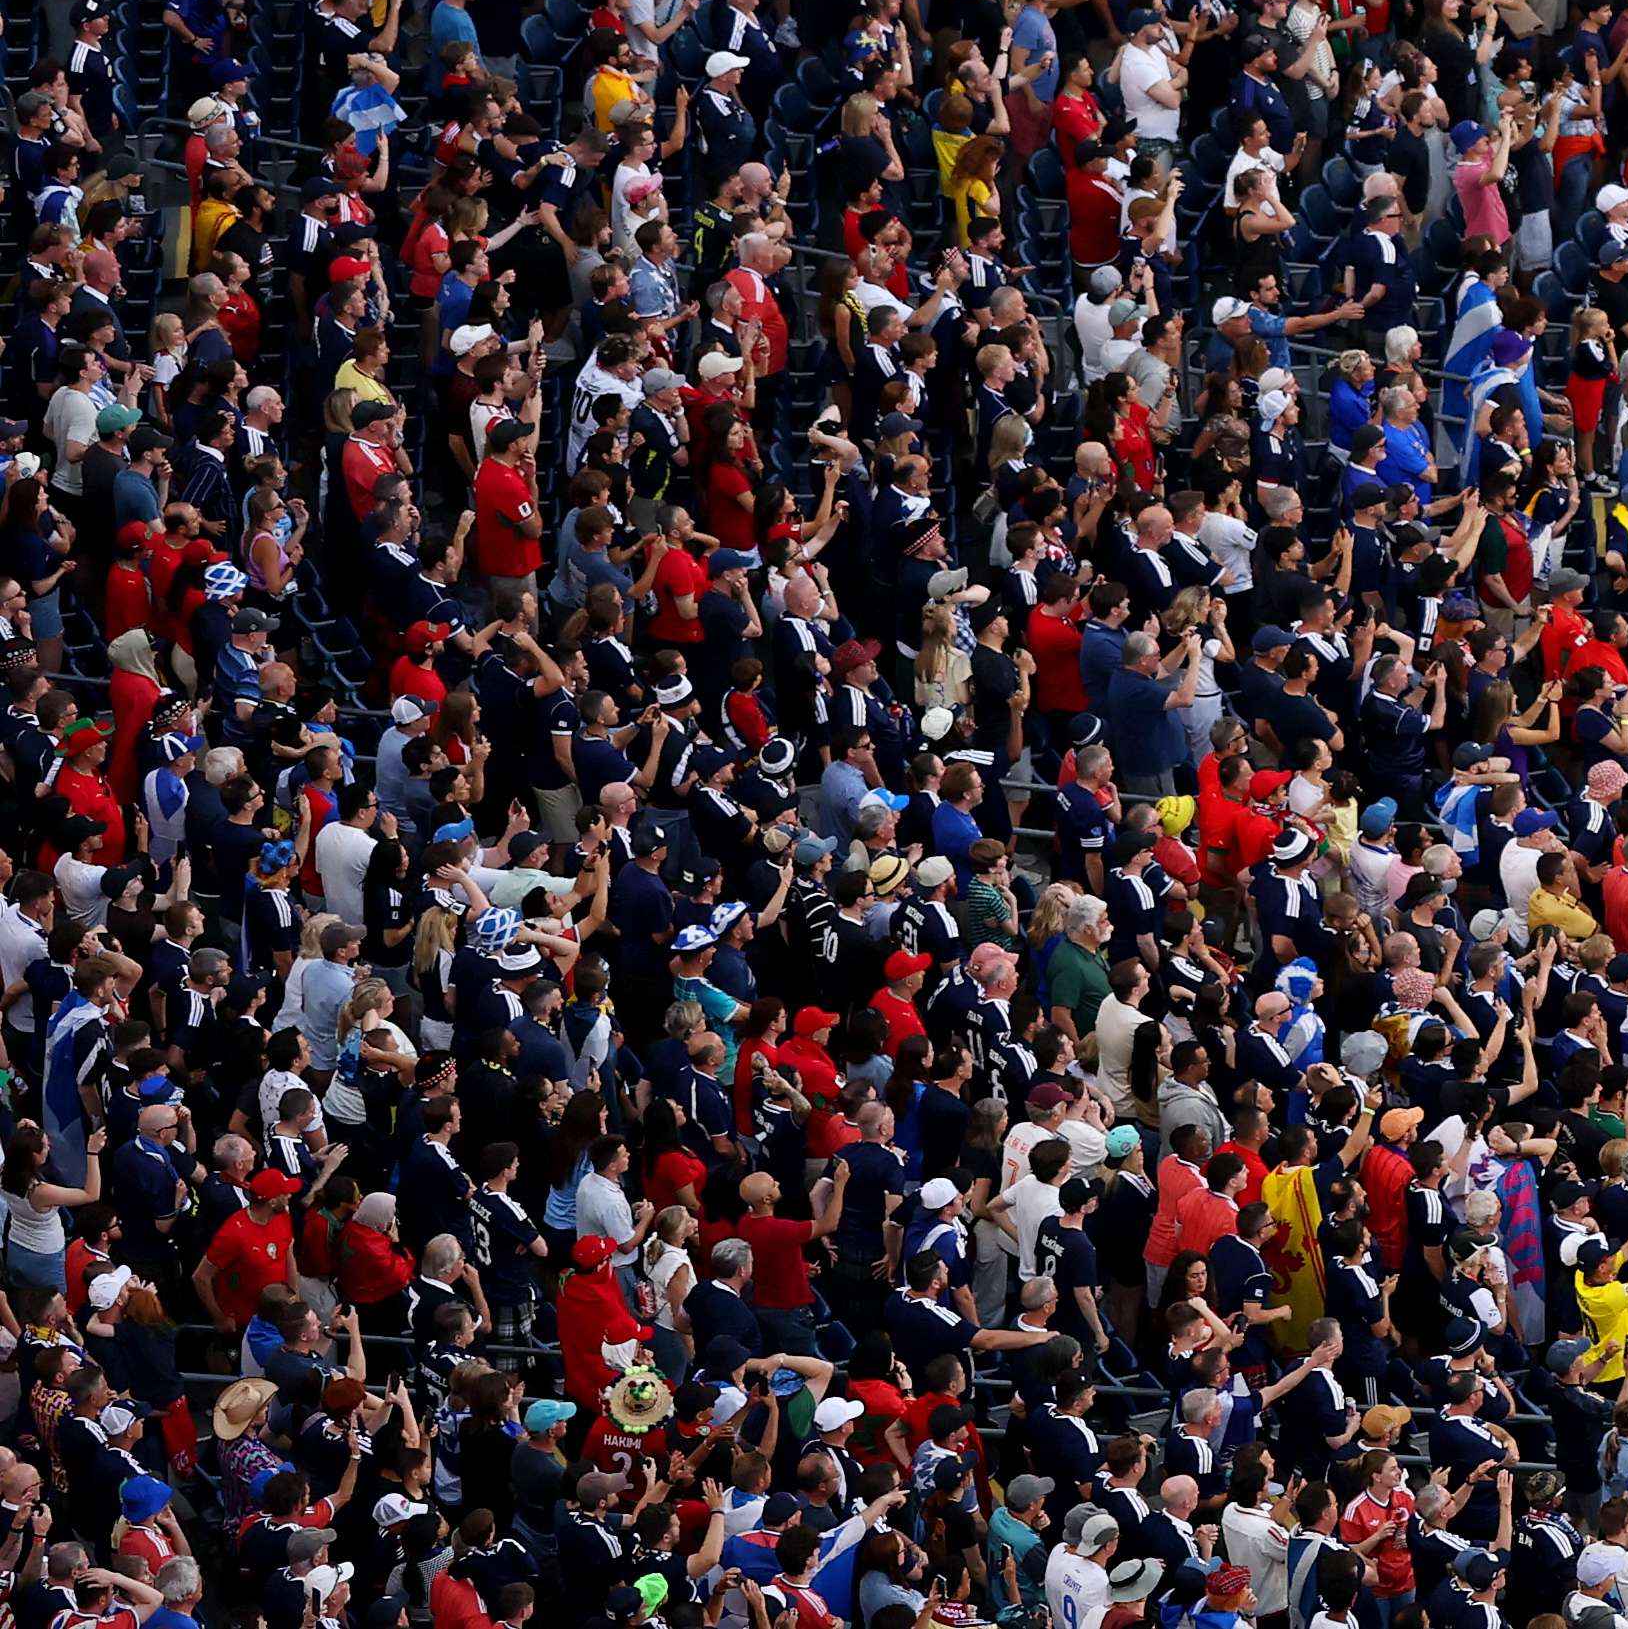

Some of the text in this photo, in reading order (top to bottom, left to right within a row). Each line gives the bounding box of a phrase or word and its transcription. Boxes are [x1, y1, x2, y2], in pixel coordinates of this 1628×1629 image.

[822, 925, 839, 964] 10
[603, 1432, 642, 1450] HAKIMI
[612, 1451, 635, 1491] 2
[1061, 1594, 1079, 1626] 9
